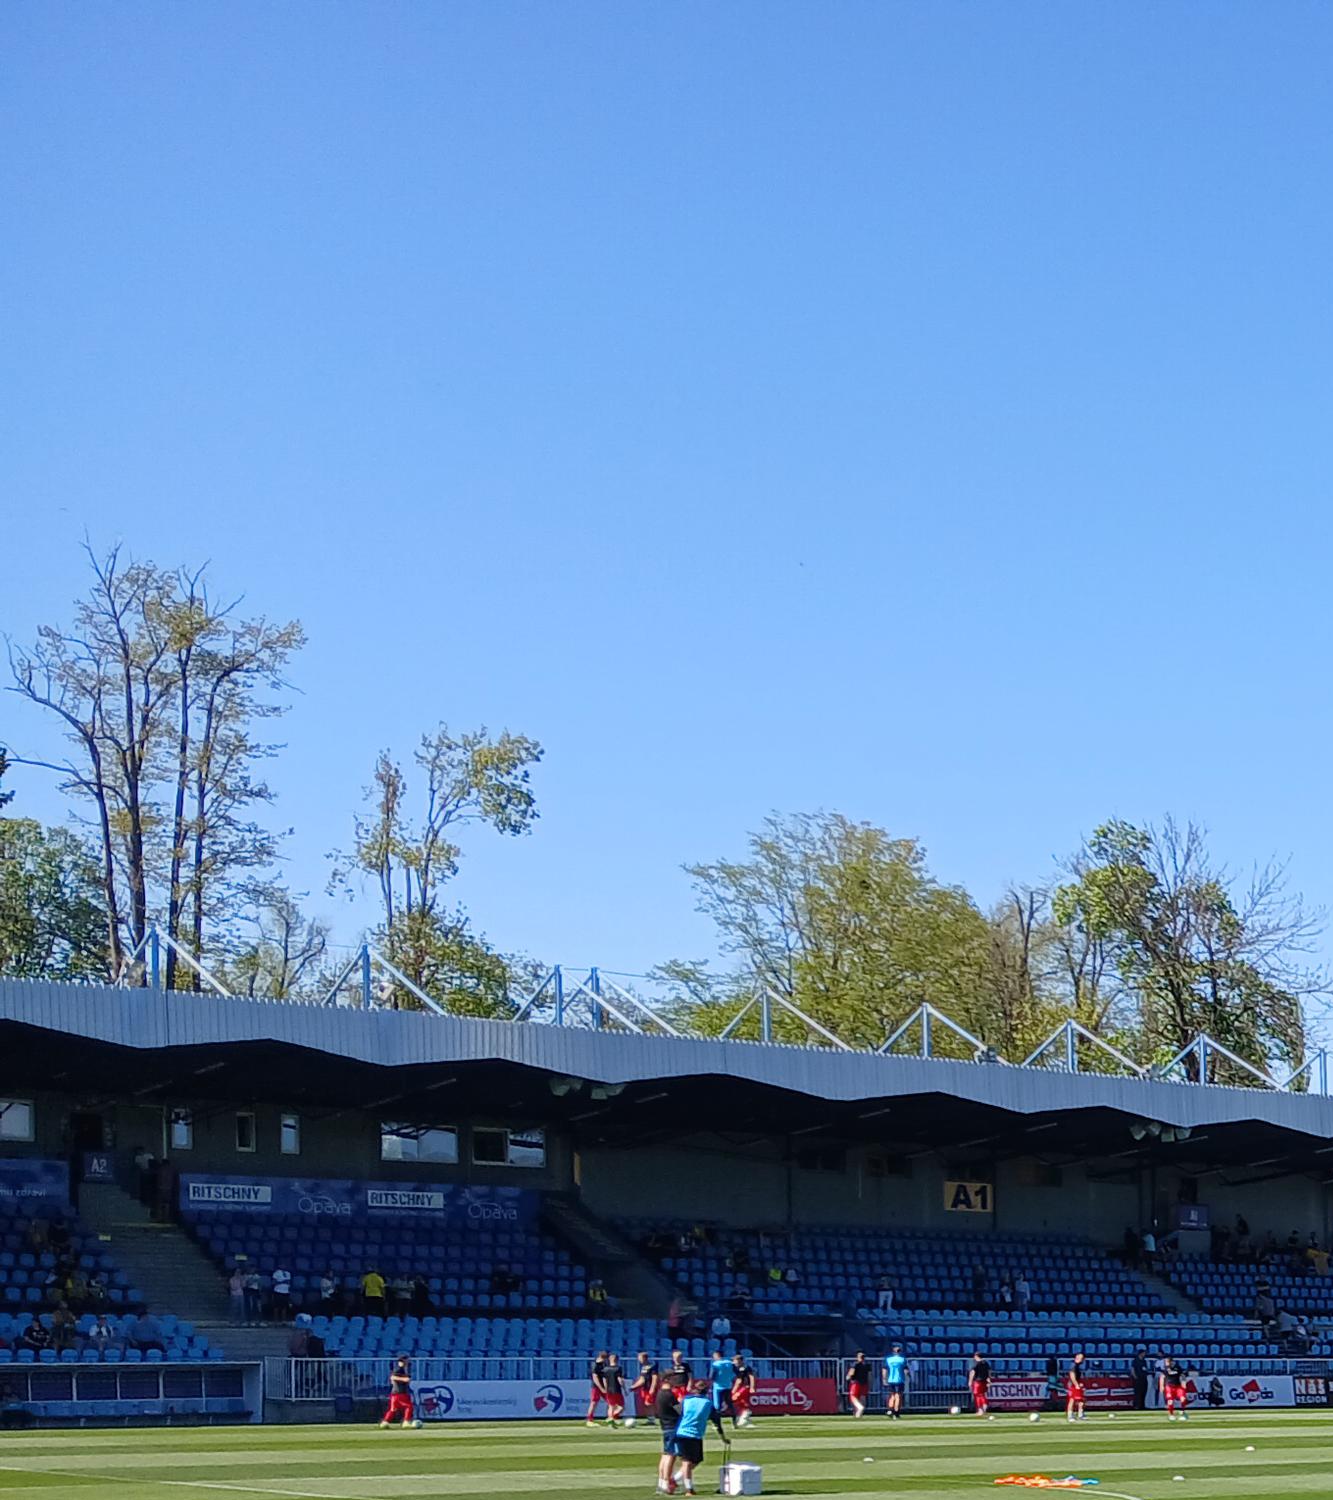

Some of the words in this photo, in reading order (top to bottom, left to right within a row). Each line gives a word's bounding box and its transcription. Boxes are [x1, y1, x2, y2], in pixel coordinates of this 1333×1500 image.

[91, 1156, 107, 1173] A2
[191, 1185, 261, 1200] RITSCHNY
[370, 1191, 434, 1207] RITSCHNY
[950, 1183, 989, 1210] A1
[298, 1196, 352, 1215] Opava
[467, 1202, 518, 1220] Opava
[986, 1383, 1042, 1398] ITSCHNY
[751, 1394, 788, 1406] ORION
